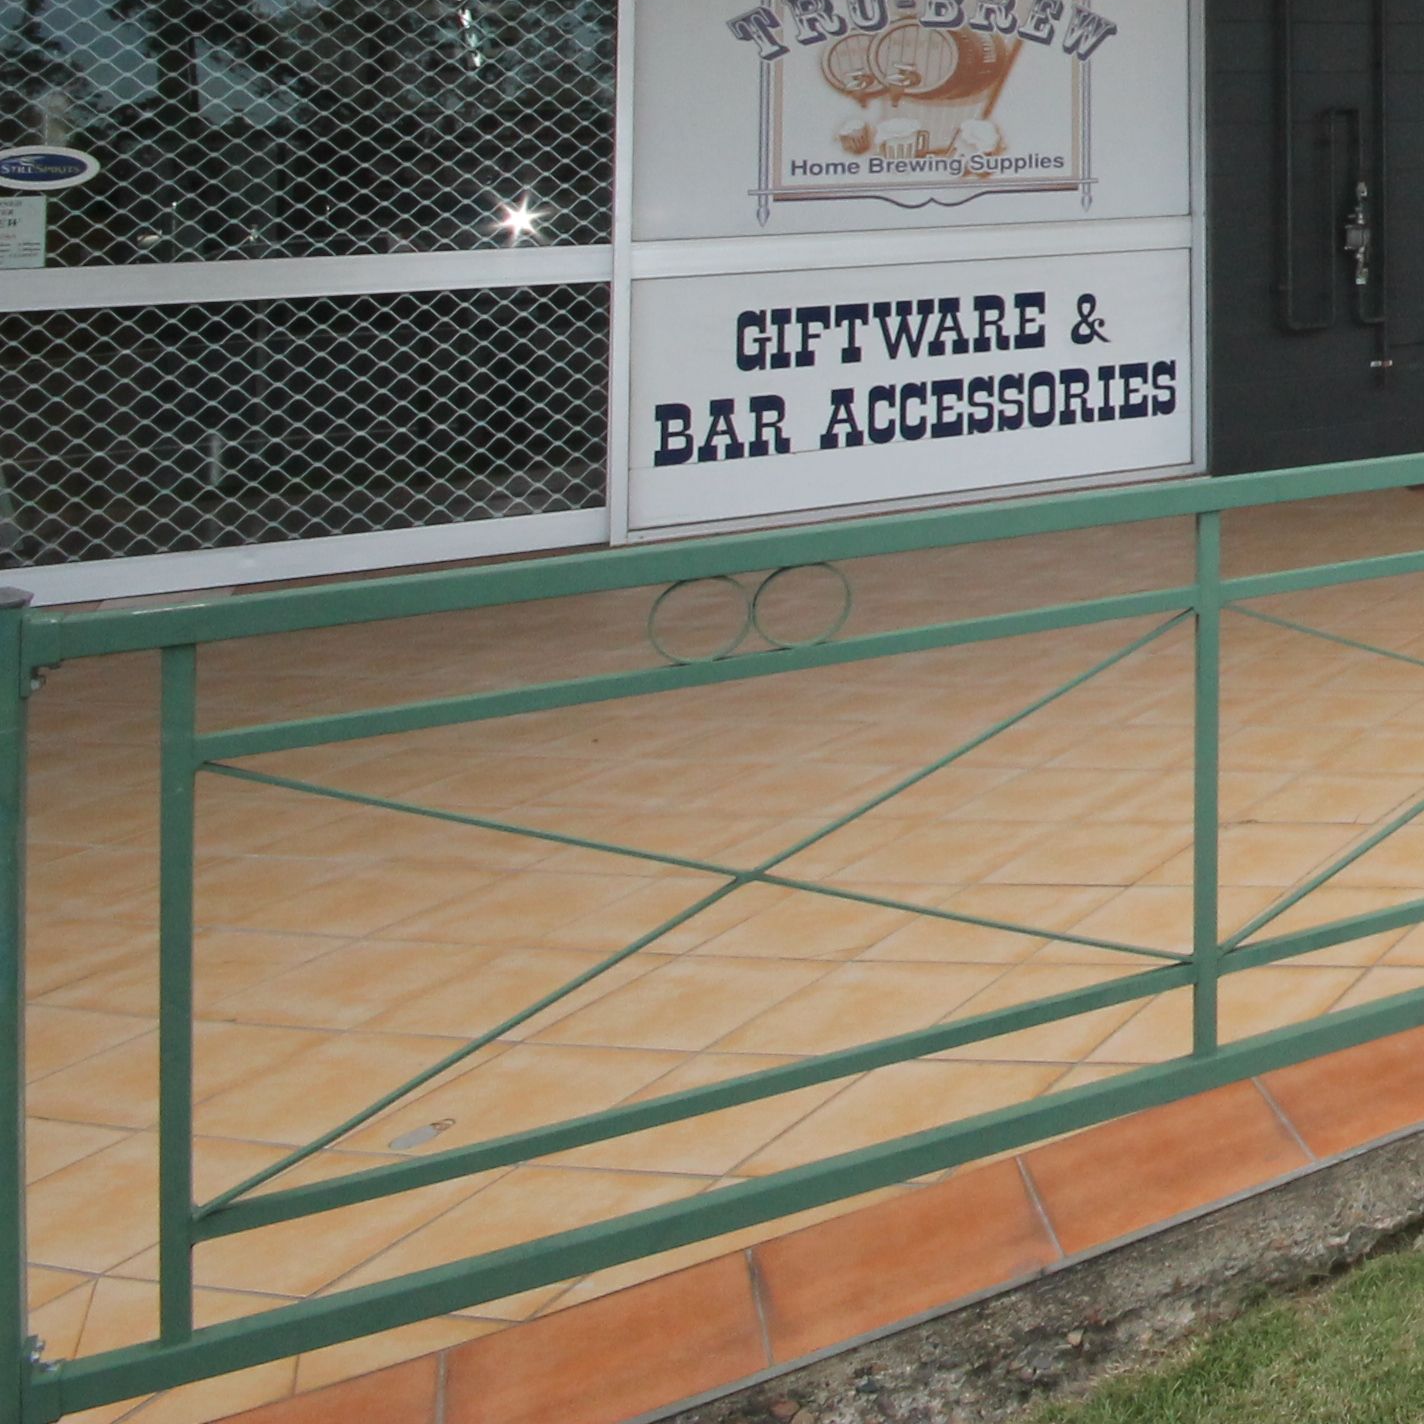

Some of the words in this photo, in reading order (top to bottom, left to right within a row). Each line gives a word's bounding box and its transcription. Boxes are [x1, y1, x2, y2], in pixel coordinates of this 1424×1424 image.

[791, 159, 861, 176] Home
[868, 154, 963, 176] Brewing
[970, 153, 1065, 173] Supplies
[735, 291, 1046, 372] GIFTWARE
[1070, 292, 1111, 345] &
[653, 394, 791, 468] BAR
[819, 359, 1177, 451] ACCESSORIES
